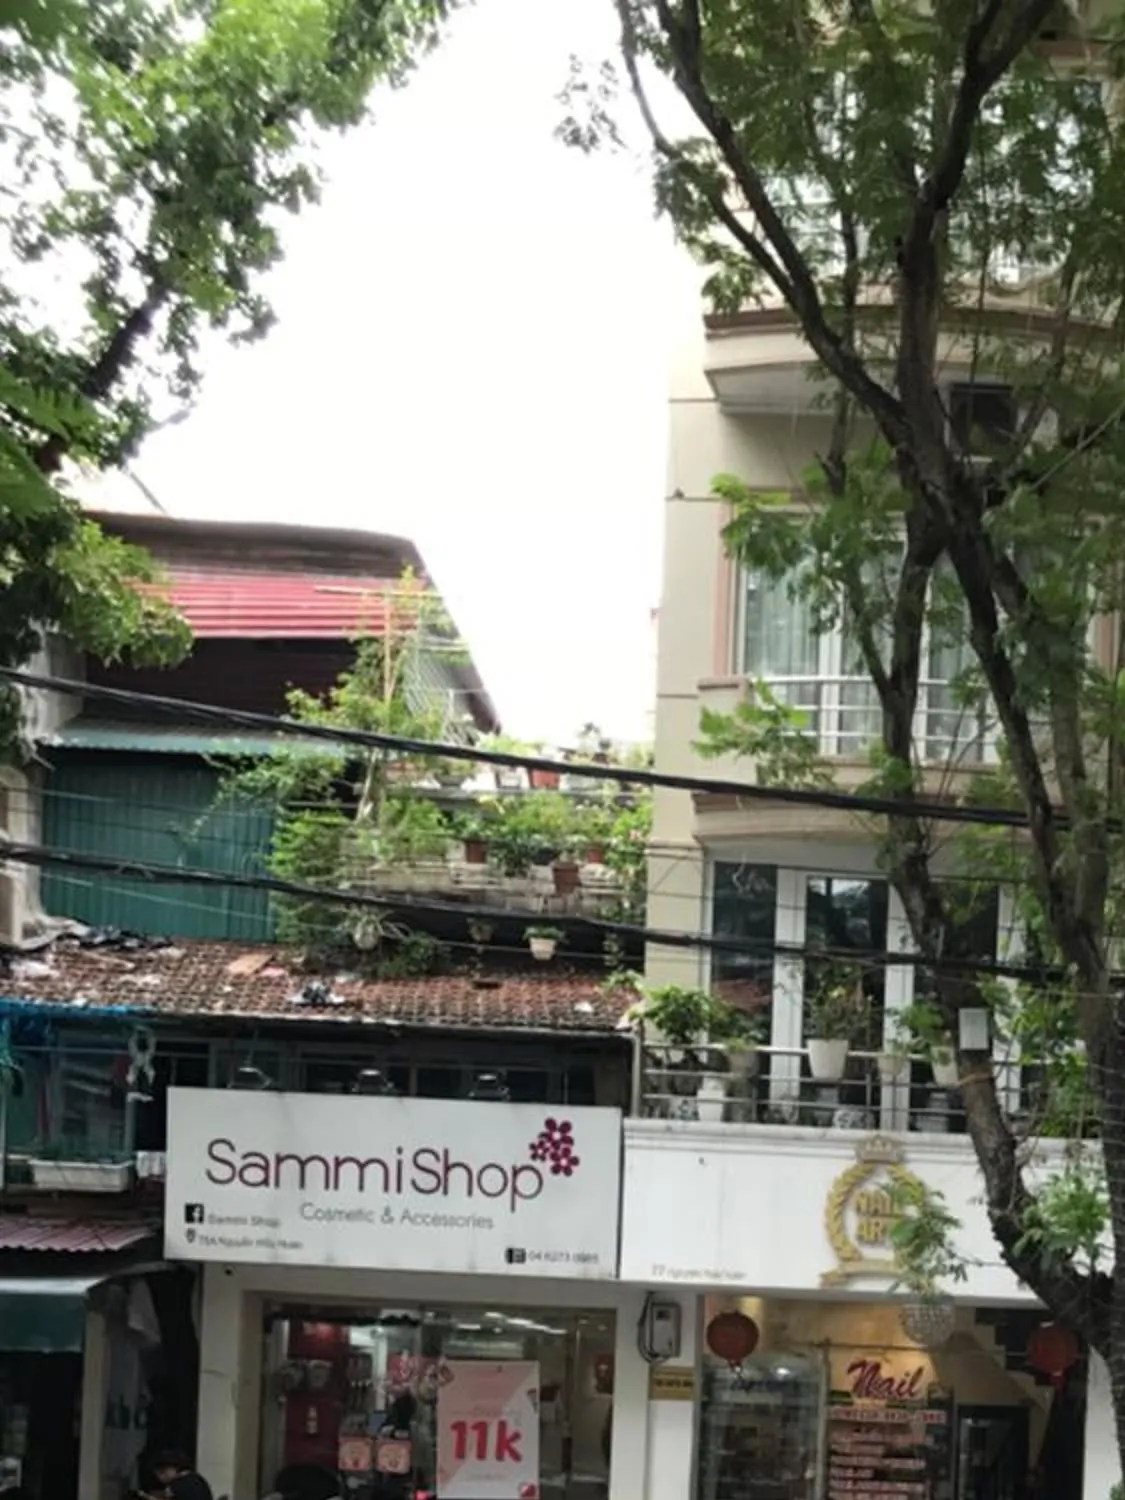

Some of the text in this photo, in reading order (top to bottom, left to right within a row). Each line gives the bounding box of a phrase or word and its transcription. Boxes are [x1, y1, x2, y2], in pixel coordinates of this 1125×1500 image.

[205, 1137, 544, 1213] SammiShop
[300, 1202, 495, 1231] Cosmetic & Accessories
[450, 1420, 522, 1462] 11k
